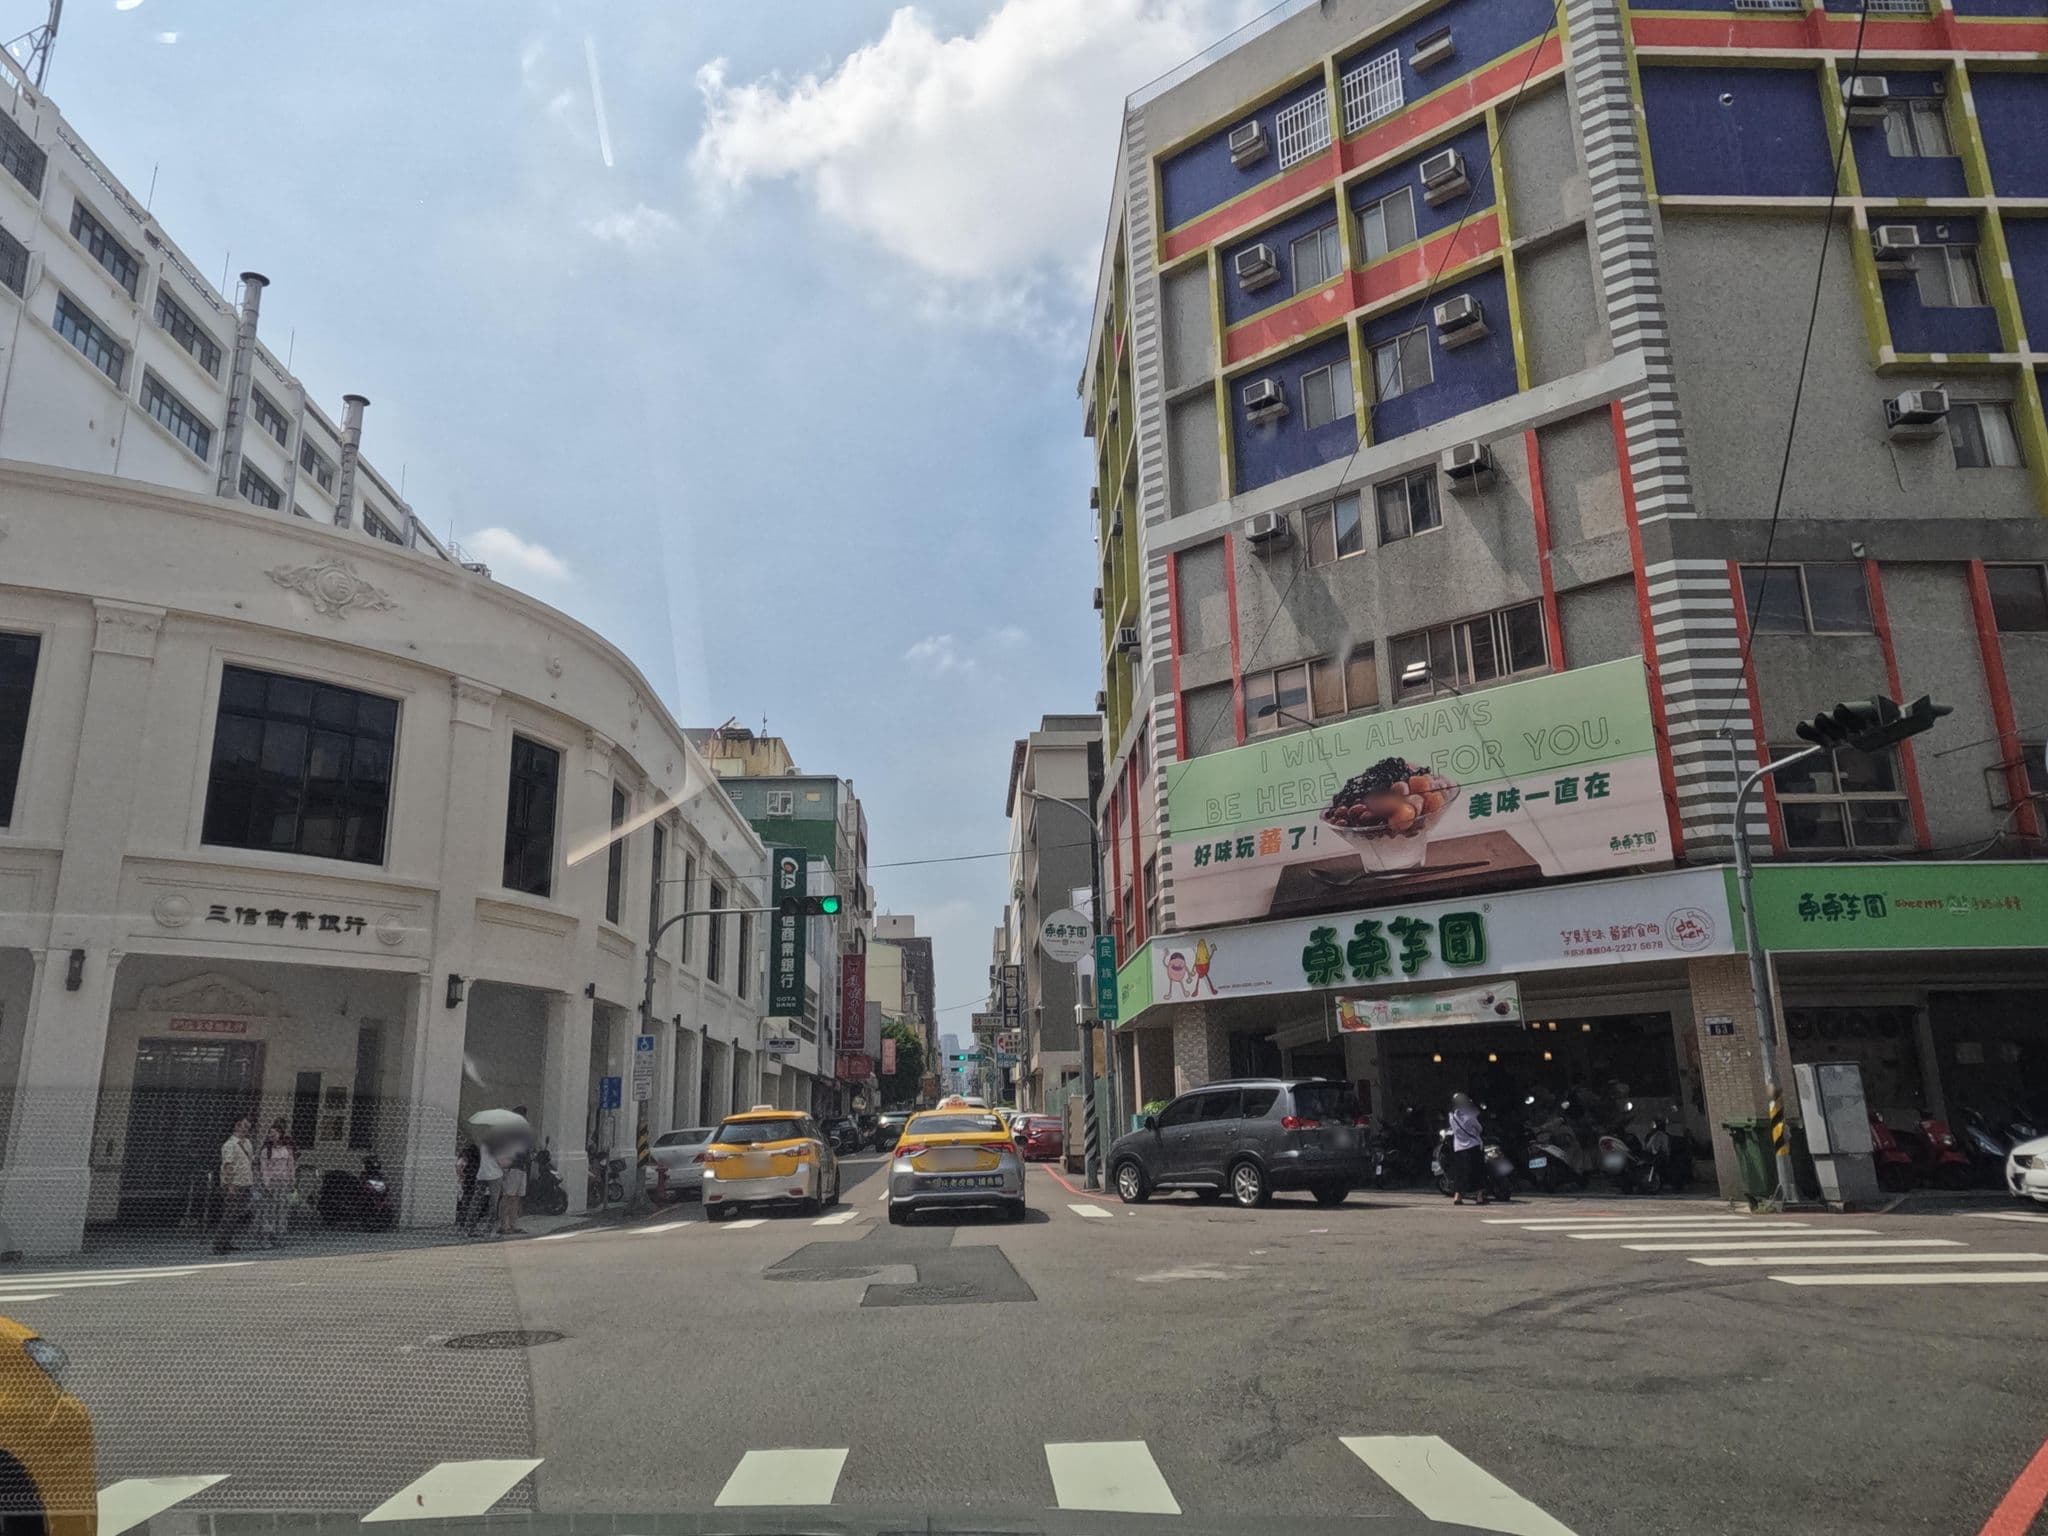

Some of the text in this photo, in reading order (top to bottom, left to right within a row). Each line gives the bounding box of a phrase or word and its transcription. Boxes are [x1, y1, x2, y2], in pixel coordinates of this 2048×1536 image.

[1260, 699, 1493, 774] I WILL ALWAYS
[1205, 716, 1622, 825] BE HERE FOR YOU.
[1468, 771, 1611, 820] 美味一直在
[205, 904, 368, 936] 三信商業銀行
[1560, 928, 1606, 946] 芋見美味
[780, 914, 796, 989] 信商業銀行
[1101, 946, 1113, 1000] 民族路
